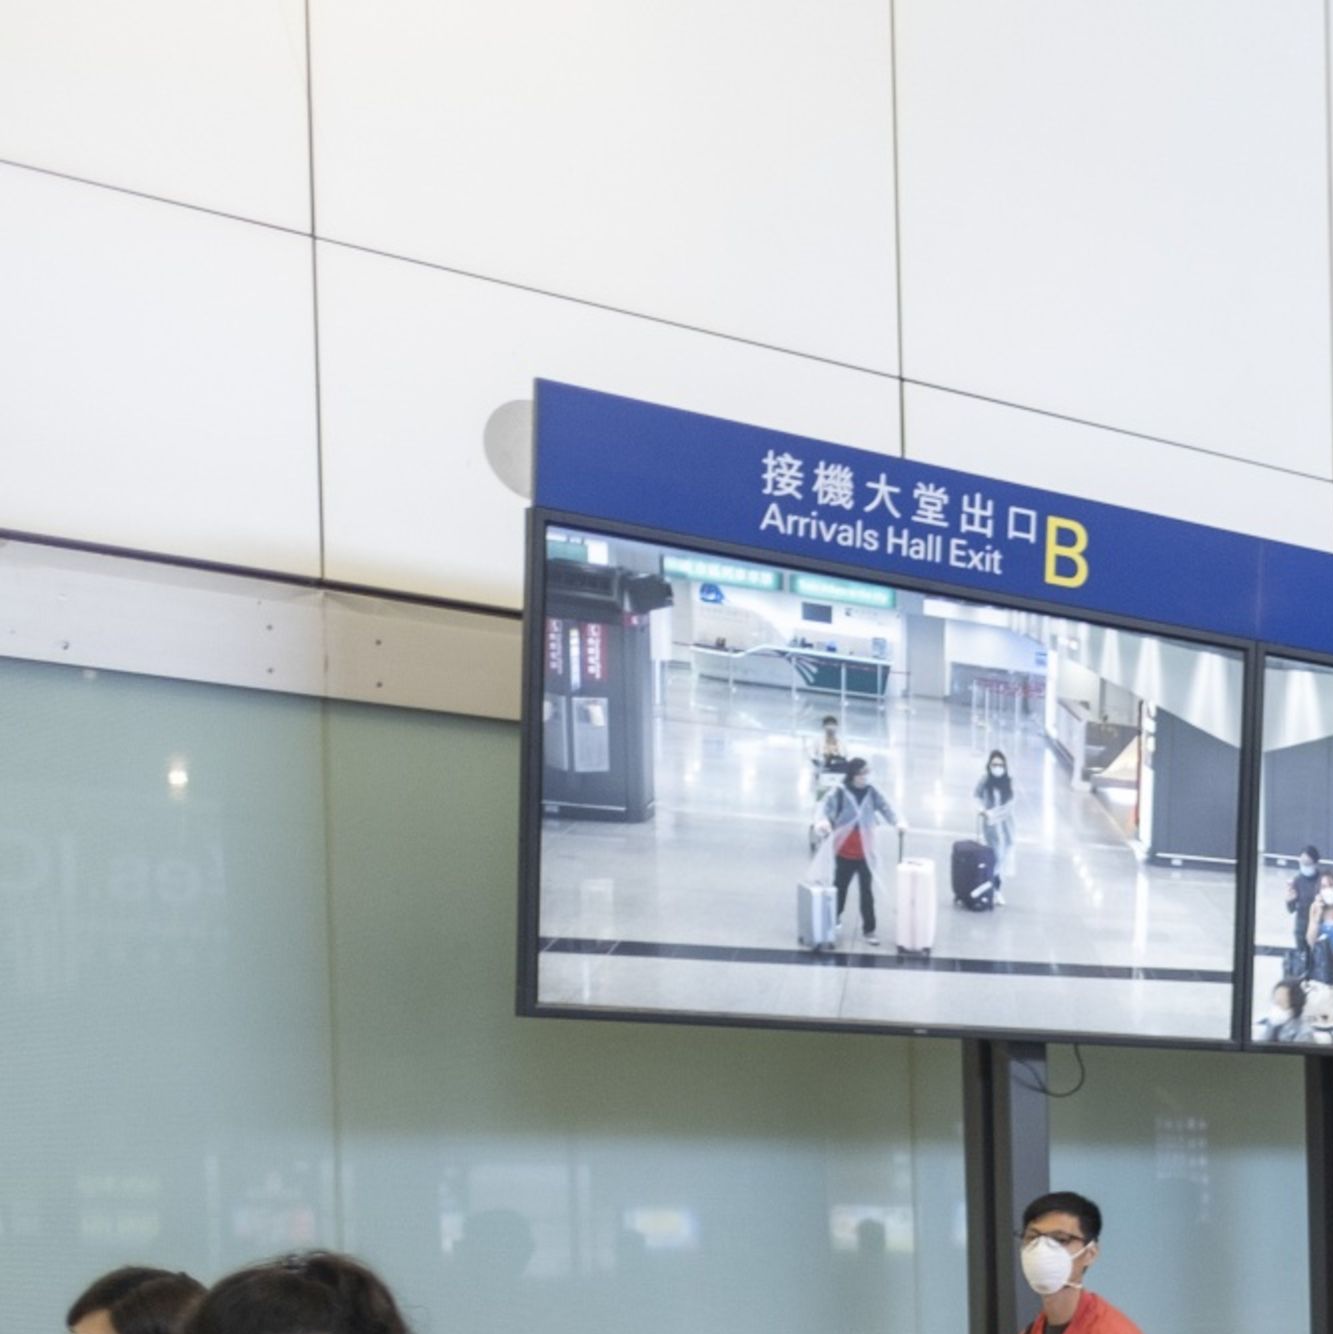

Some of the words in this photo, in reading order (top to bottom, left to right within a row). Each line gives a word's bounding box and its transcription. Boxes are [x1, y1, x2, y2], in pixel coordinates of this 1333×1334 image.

[761, 449, 1038, 544] 接機大堂出口
[759, 502, 879, 552] Arrivals
[886, 525, 942, 564] Hall
[949, 537, 1003, 575] Exit
[1044, 515, 1089, 589] B
